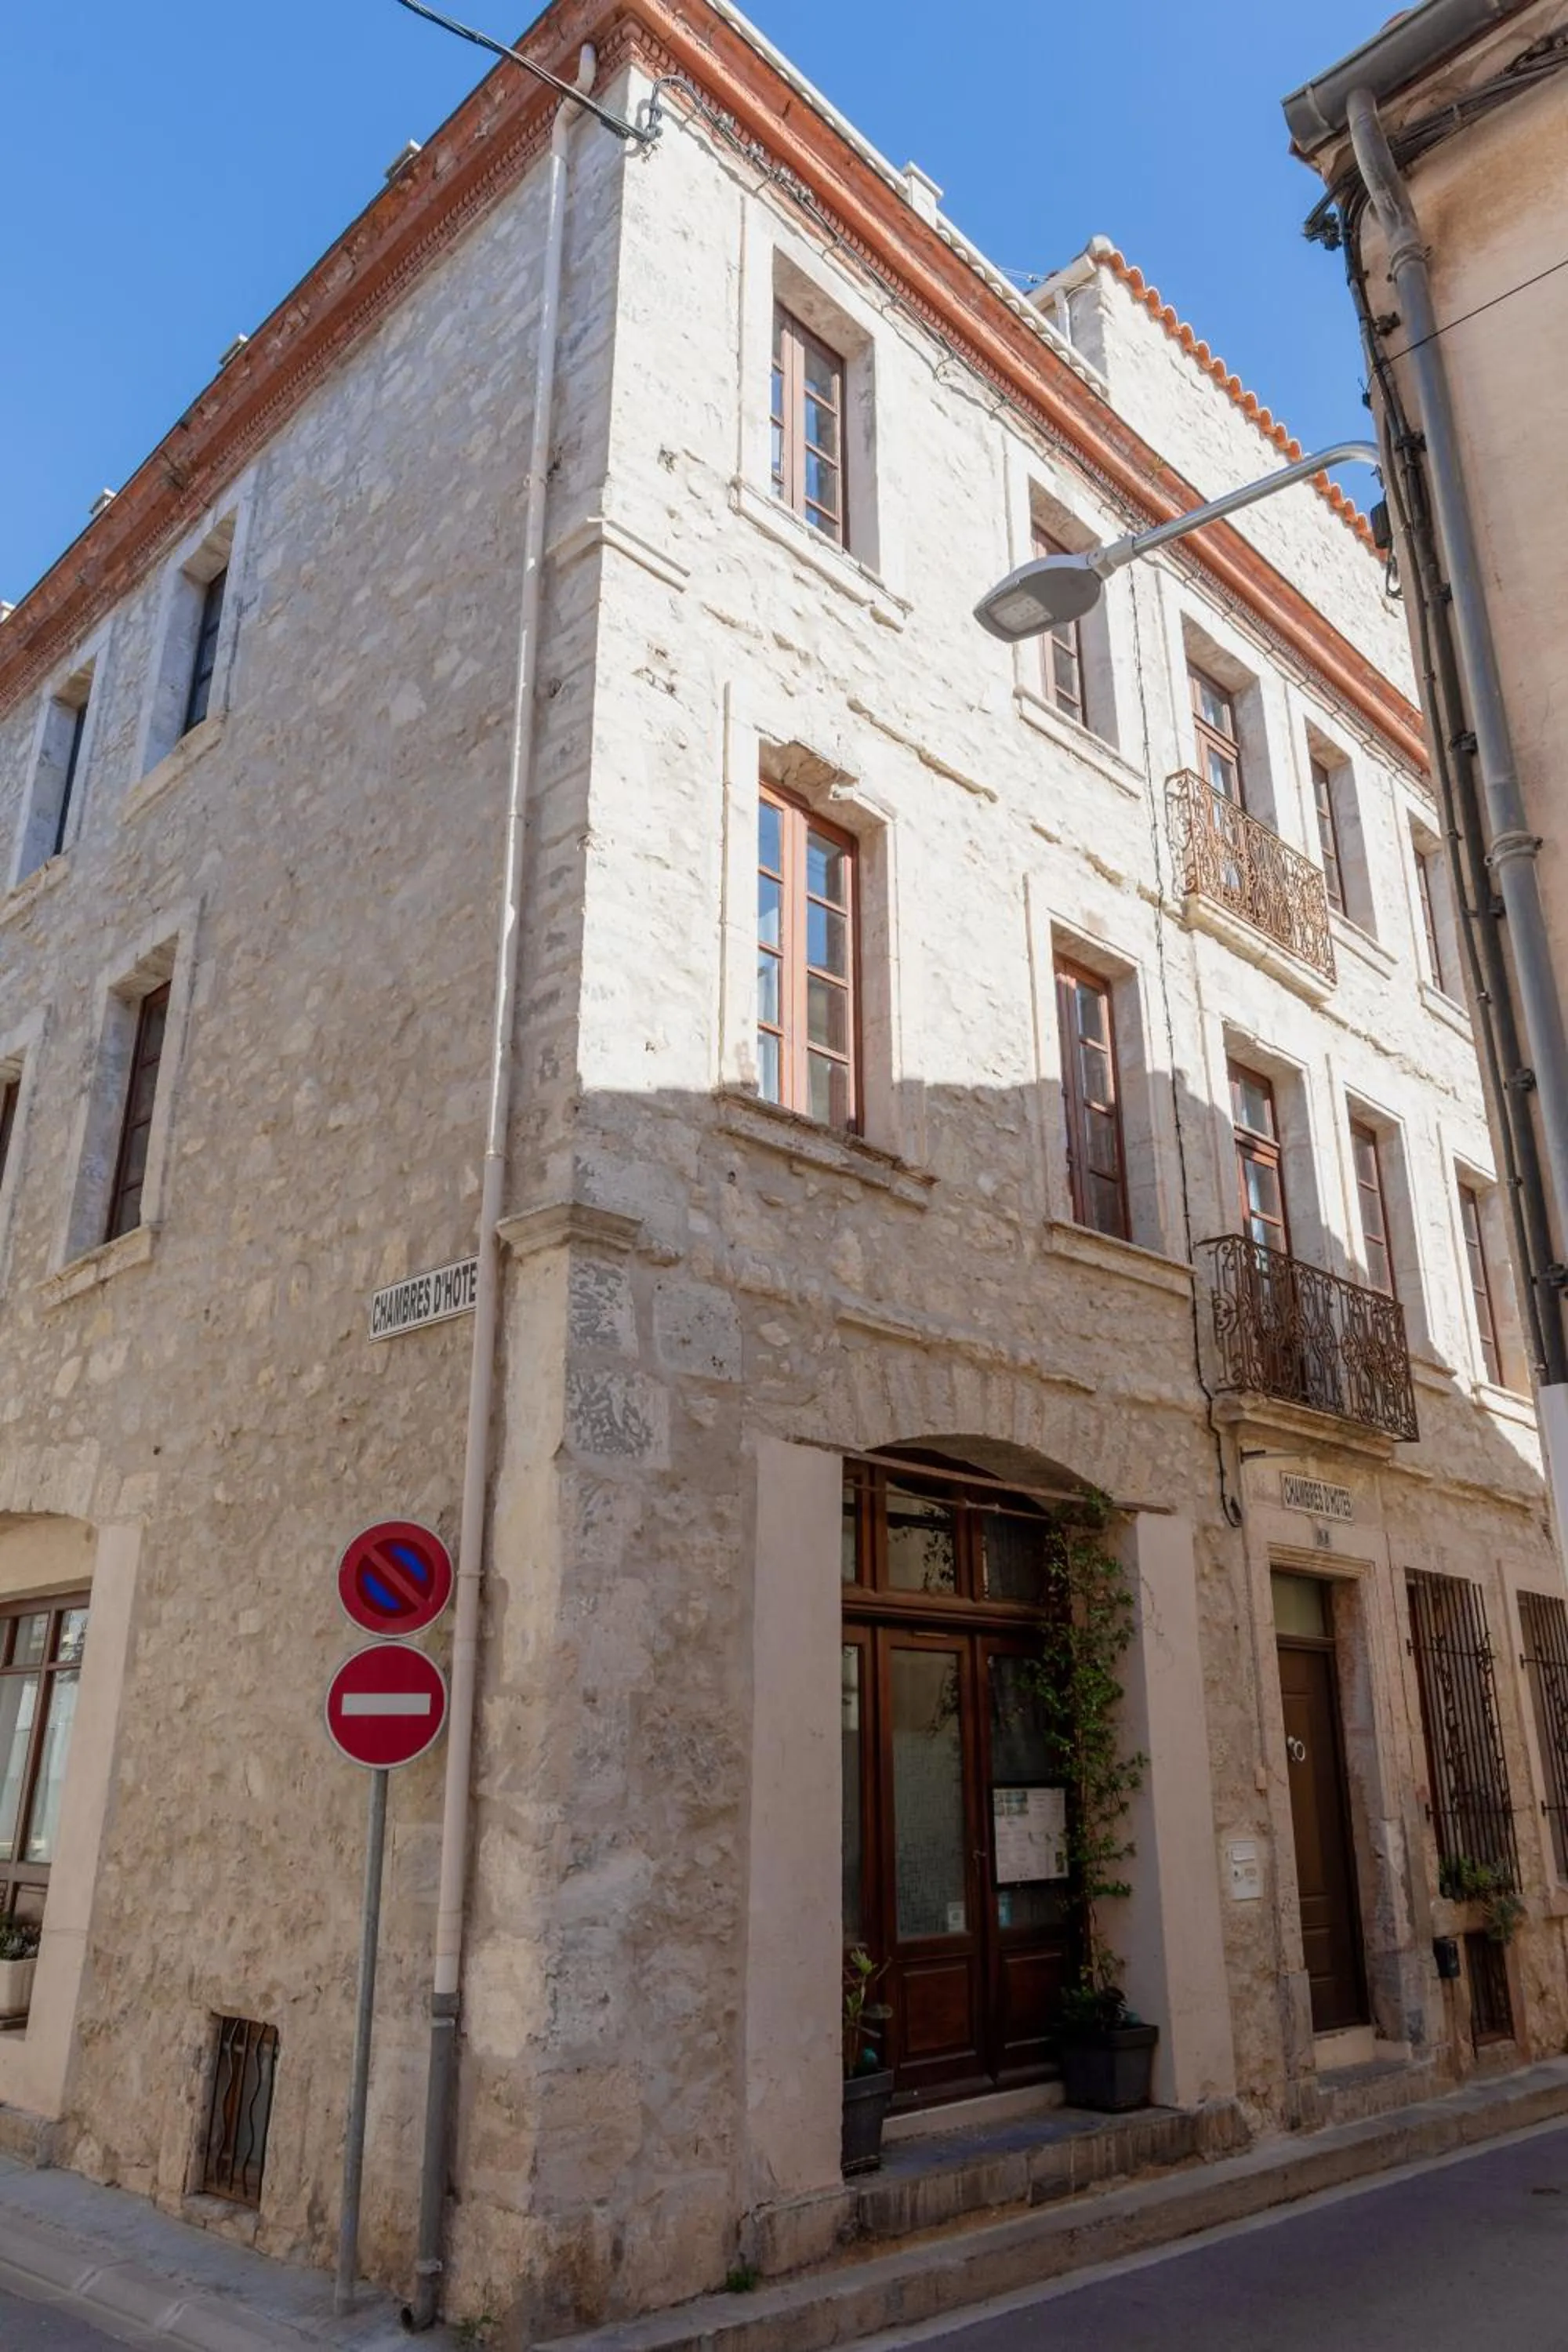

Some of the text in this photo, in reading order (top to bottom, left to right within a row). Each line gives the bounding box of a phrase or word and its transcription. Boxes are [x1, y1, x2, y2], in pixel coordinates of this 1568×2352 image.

[372, 1261, 477, 1334] CHAMBRES D'HOTE
[1285, 1476, 1323, 1511] CHAMBRES
